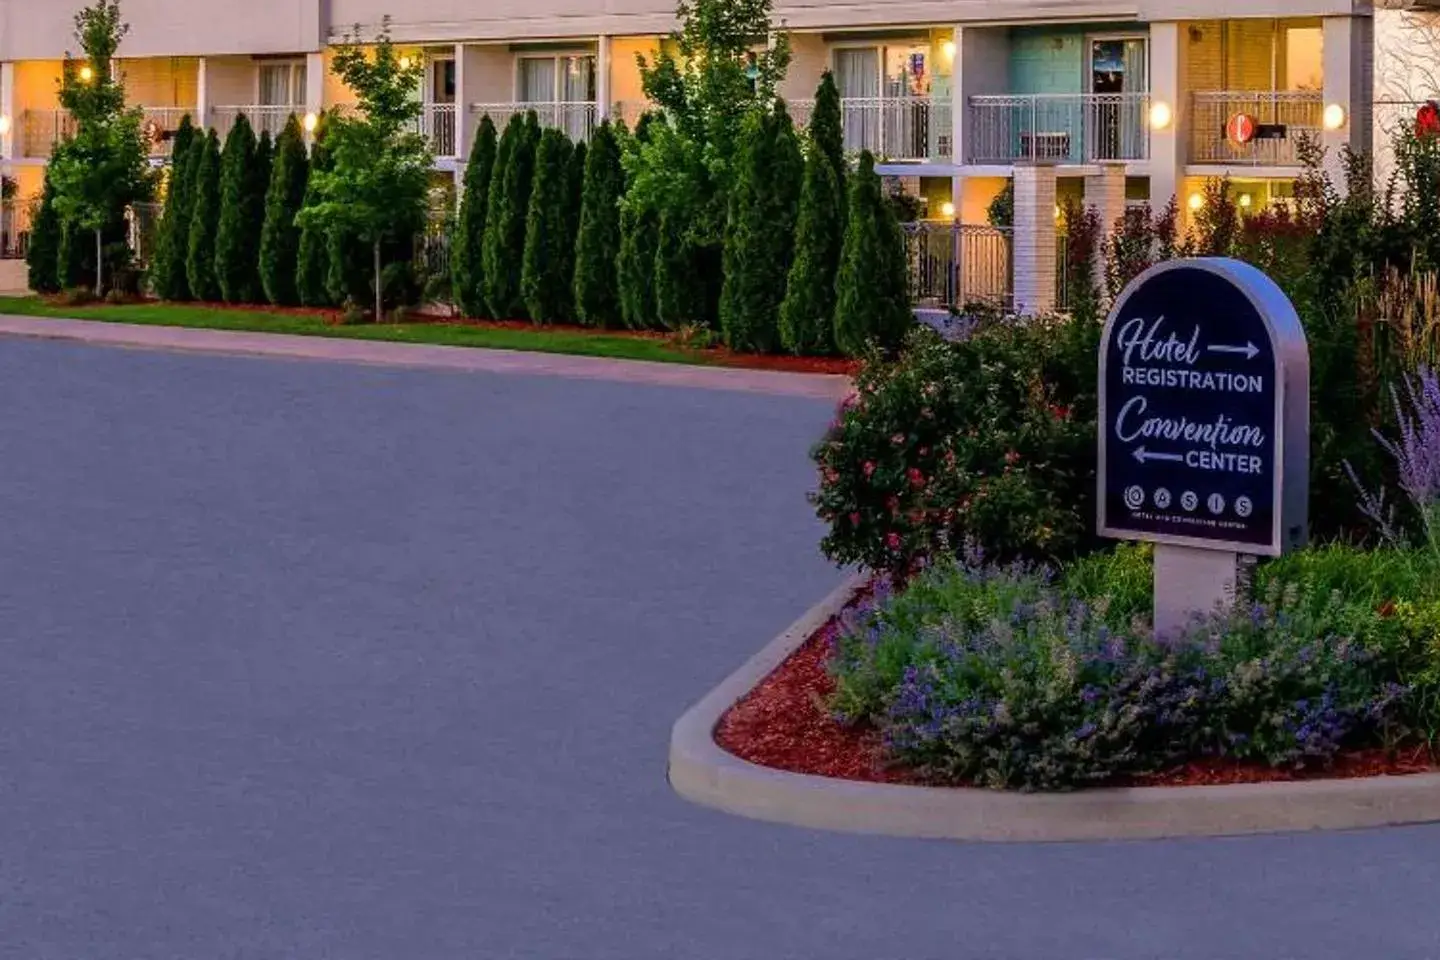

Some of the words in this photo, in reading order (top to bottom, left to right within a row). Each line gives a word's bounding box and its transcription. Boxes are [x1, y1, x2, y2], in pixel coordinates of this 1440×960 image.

[1117, 315, 1200, 365] Hotel
[1122, 367, 1263, 392] REGISTRATION
[1115, 395, 1264, 449] Convention
[1186, 451, 1262, 473] CENTER
[1128, 487, 1250, 516] OASIS
